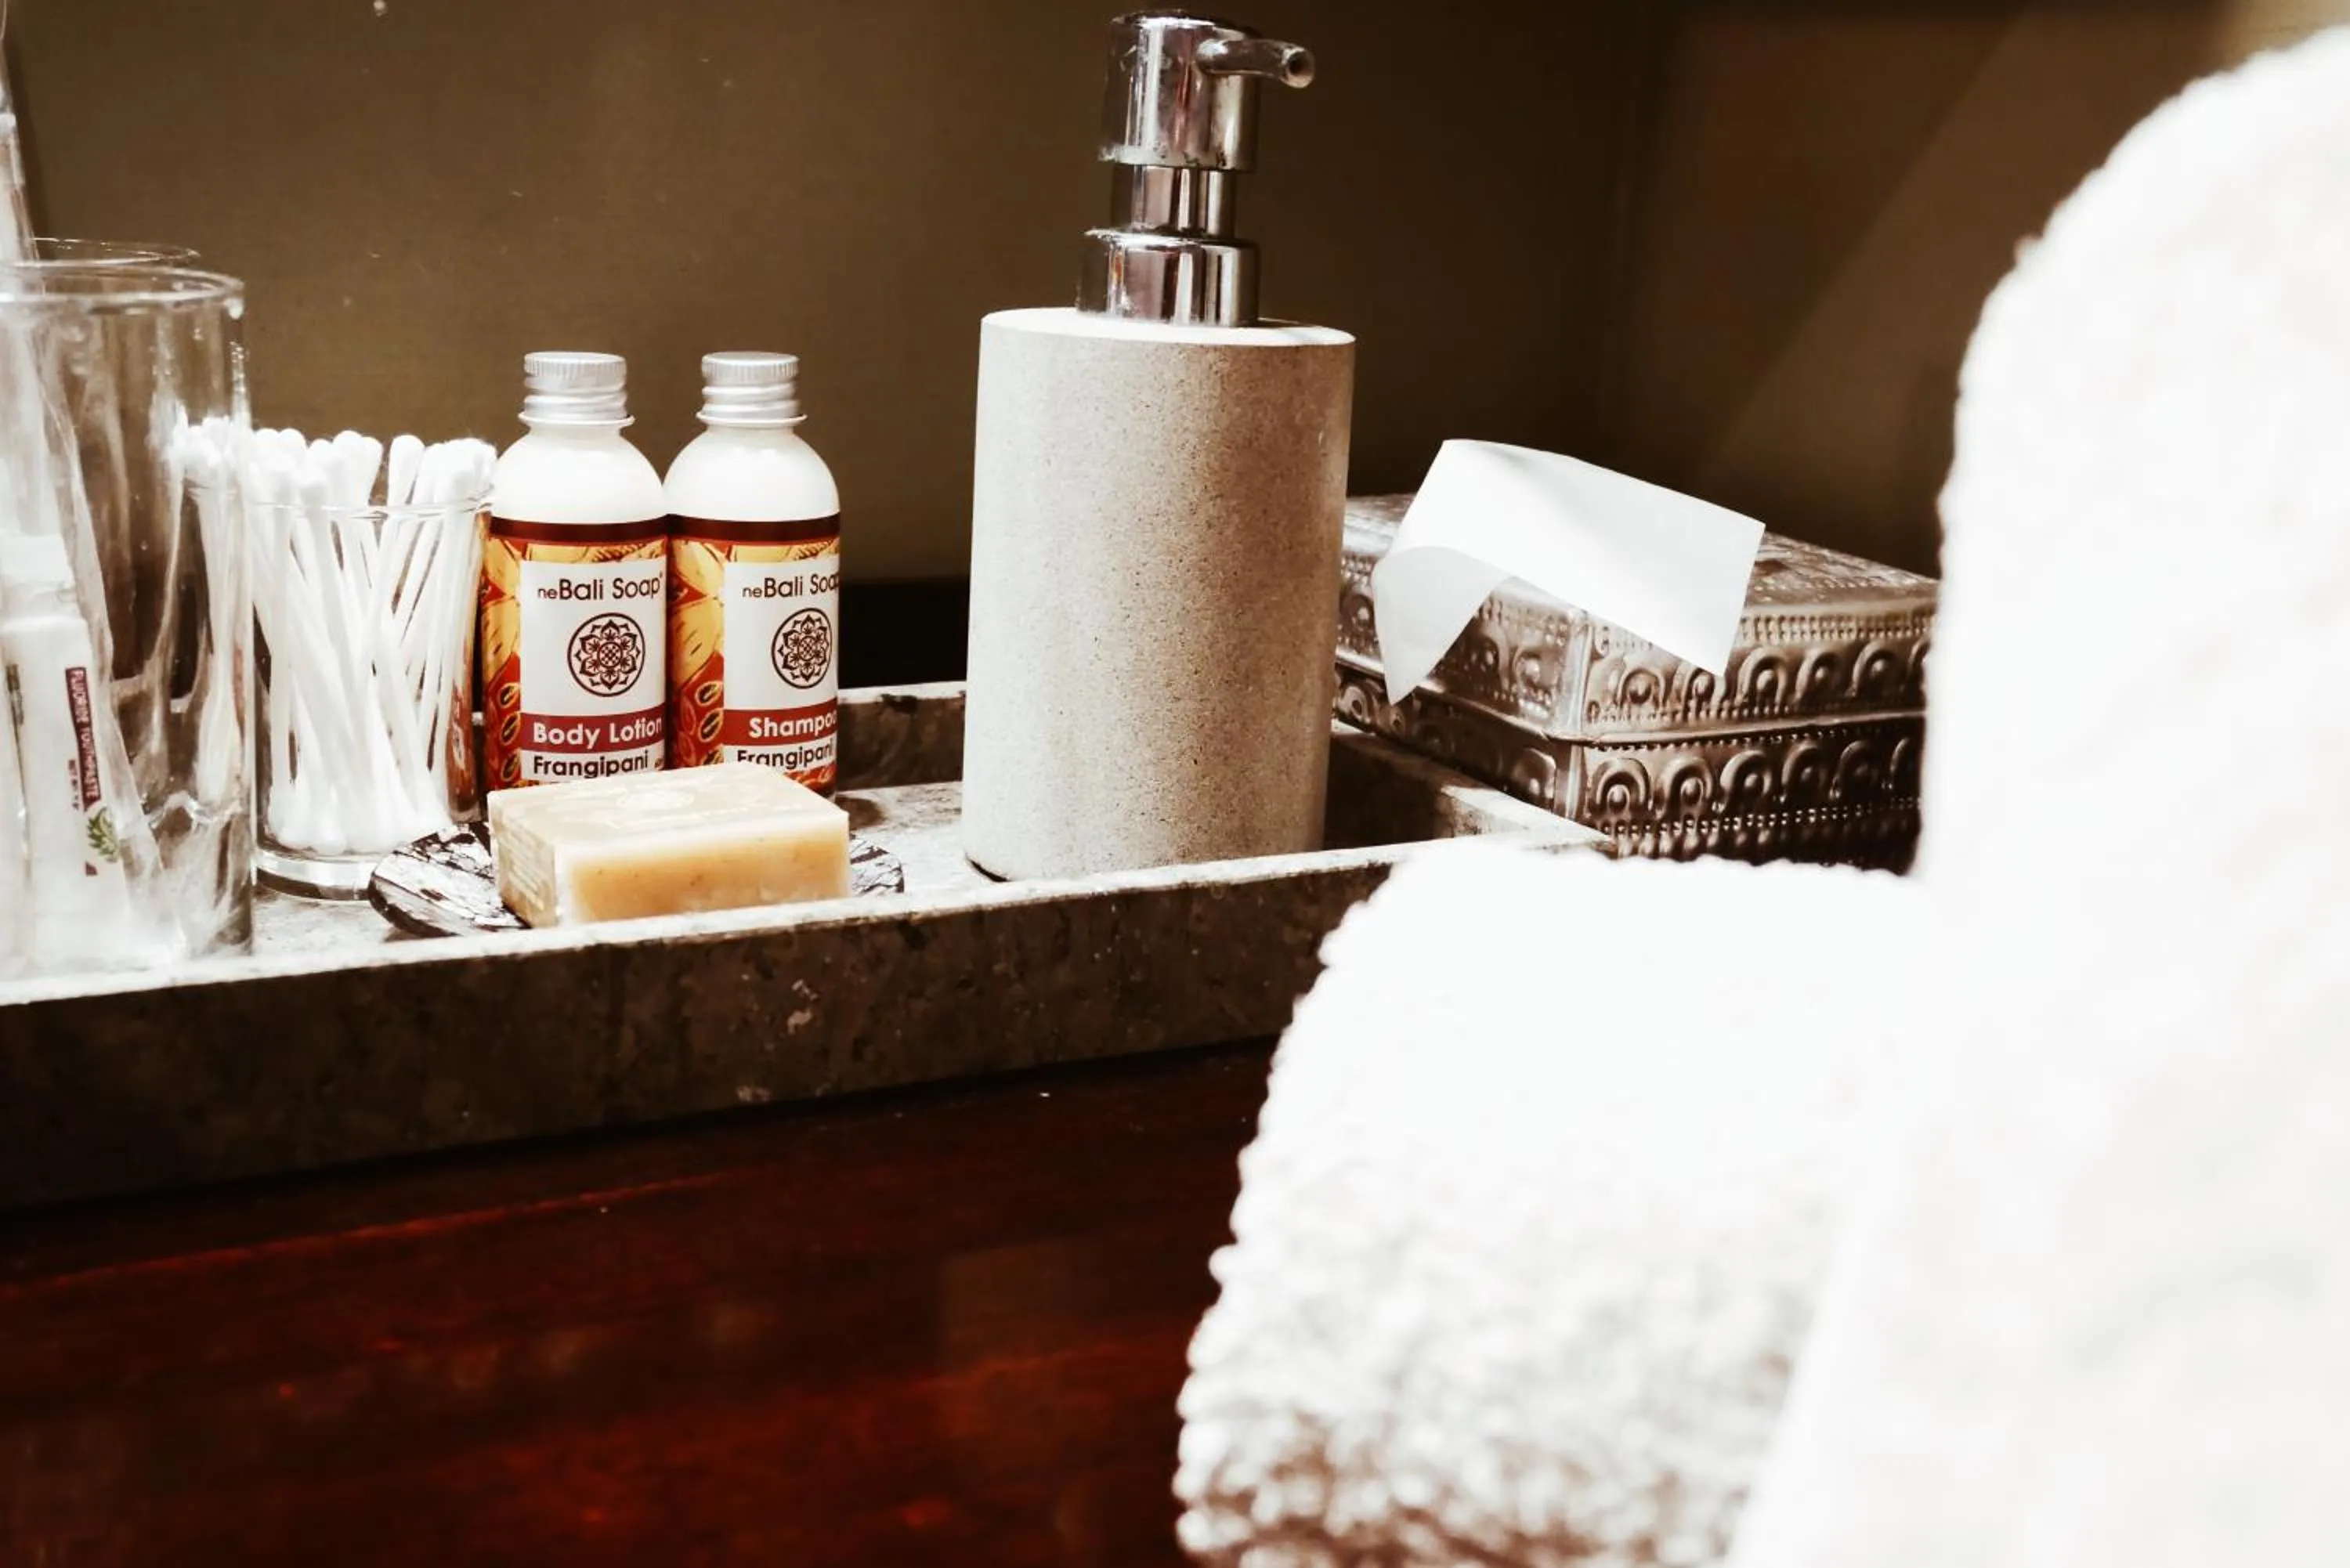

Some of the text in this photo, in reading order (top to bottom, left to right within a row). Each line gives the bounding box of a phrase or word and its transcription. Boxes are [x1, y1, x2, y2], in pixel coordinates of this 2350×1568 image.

[71, 669, 99, 799] FLUORIDE TOOTHPASTE
[533, 717, 662, 750] Body Lotion
[533, 750, 649, 779] Frangipani
